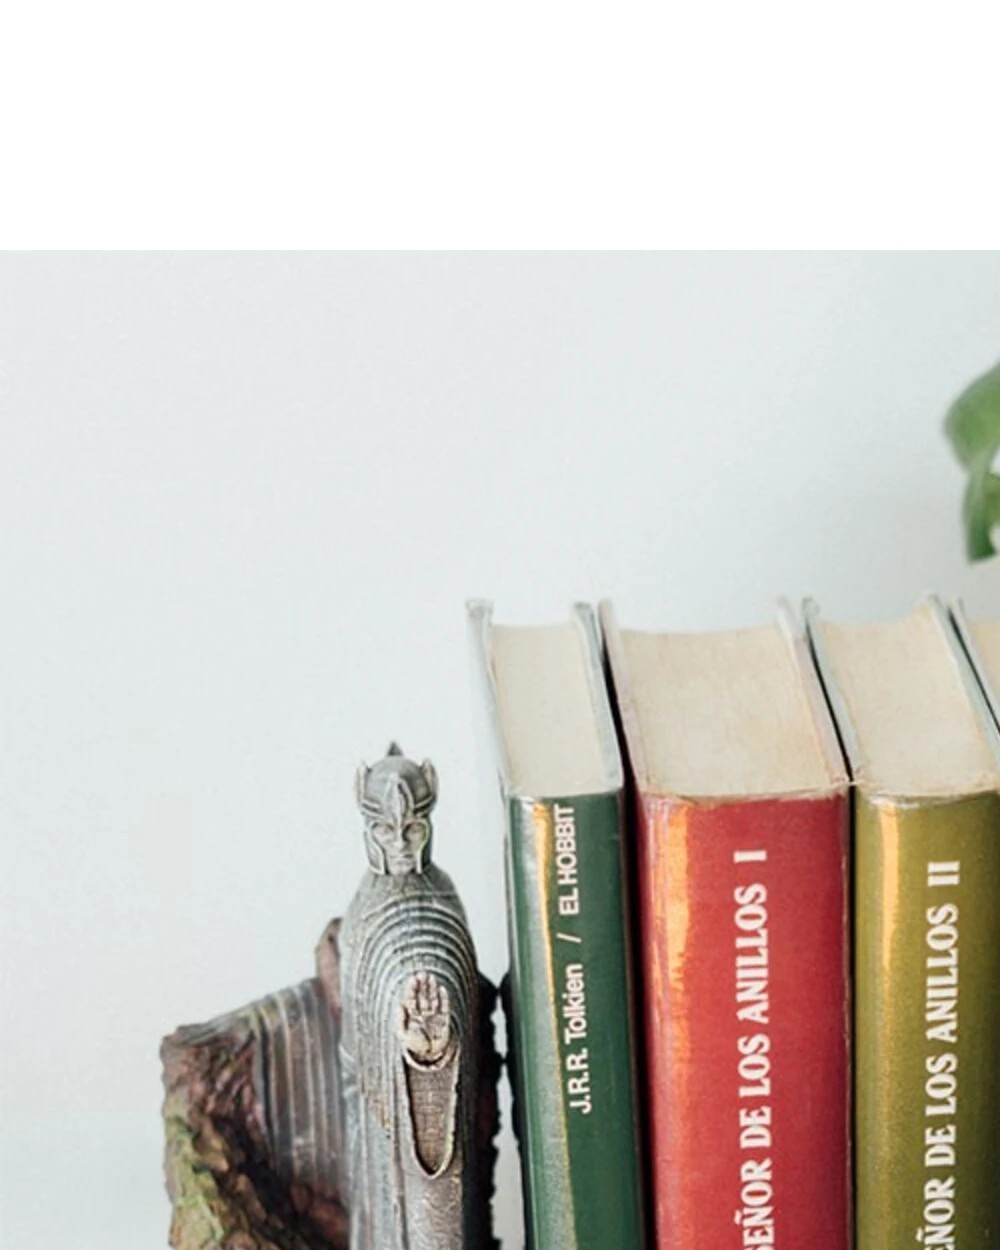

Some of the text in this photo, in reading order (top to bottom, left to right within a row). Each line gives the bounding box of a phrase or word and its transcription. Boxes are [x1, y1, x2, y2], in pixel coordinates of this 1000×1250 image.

[734, 851, 766, 862] I
[928, 862, 959, 886] II
[554, 804, 591, 1114] J.R.R. Tolkien / EL HOBBIT
[734, 884, 768, 1023] ANILLOS
[926, 904, 957, 1042] ANILLOS
[738, 1034, 770, 1097] LOS
[926, 1054, 957, 1116] LOS
[740, 1106, 771, 1148] DE
[925, 1125, 955, 1166] DE
